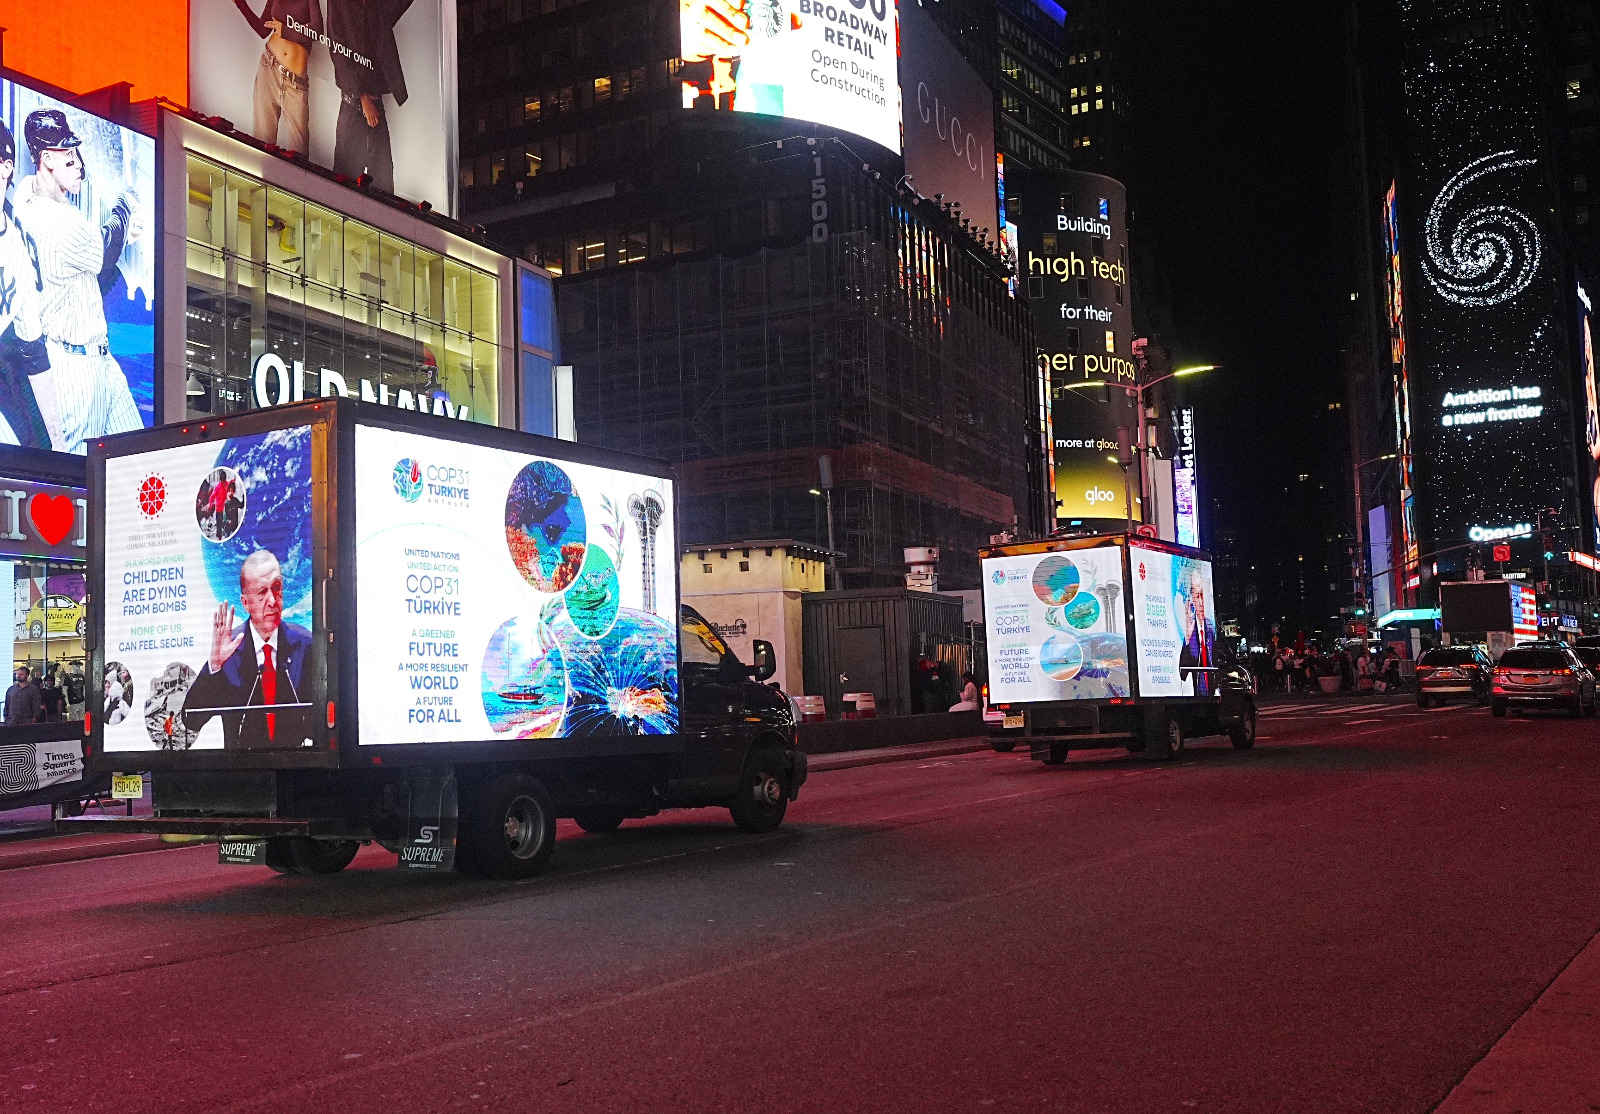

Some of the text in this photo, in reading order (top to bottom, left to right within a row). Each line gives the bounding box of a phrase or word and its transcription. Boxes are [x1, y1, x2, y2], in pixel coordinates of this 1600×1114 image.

[800, 0, 887, 46] BROADWAY
[287, 14, 373, 70] Denim on your own.
[825, 26, 874, 60] RETAIL
[812, 50, 884, 91] Open During
[811, 69, 885, 107] Construction
[918, 82, 985, 180] GUCCI
[812, 157, 828, 242] 1500
[1057, 214, 1110, 240] Building
[1028, 250, 1125, 284] high tech
[1060, 303, 1112, 322] for their
[1442, 386, 1541, 407] Ambition has
[1442, 404, 1543, 426] a new frontier
[1180, 409, 1193, 450] Locker
[1085, 438, 1094, 448] at
[427, 465, 469, 485] COP31
[1085, 486, 1114, 505] gloo
[129, 531, 167, 541] DIRECTORATE
[1469, 523, 1532, 541] OpenAI
[138, 557, 161, 566] WORLD
[162, 554, 185, 564] WHERE
[405, 548, 460, 560] UNITED NATIONS
[124, 566, 184, 585] CHILDREN
[407, 561, 459, 573] UNITED ACTION
[123, 584, 187, 603] ARE DYING
[406, 574, 459, 596] COP31
[124, 600, 187, 616] FROM BOMBS
[996, 615, 1029, 625] COP31
[131, 624, 182, 636] NONE OF US
[412, 629, 455, 638] A GREENER
[119, 637, 194, 652] CAN FEEL SECURE
[409, 642, 459, 657] FUTURE
[398, 662, 468, 672] A MORE RESILIENT
[410, 675, 459, 690] WORLD
[416, 697, 453, 705] A FUTURE
[409, 709, 462, 723] FOR ALL
[43, 760, 75, 770] Square
[45, 752, 75, 761] Times
[221, 843, 256, 856] SUPREME
[402, 847, 444, 861] SUPREME
